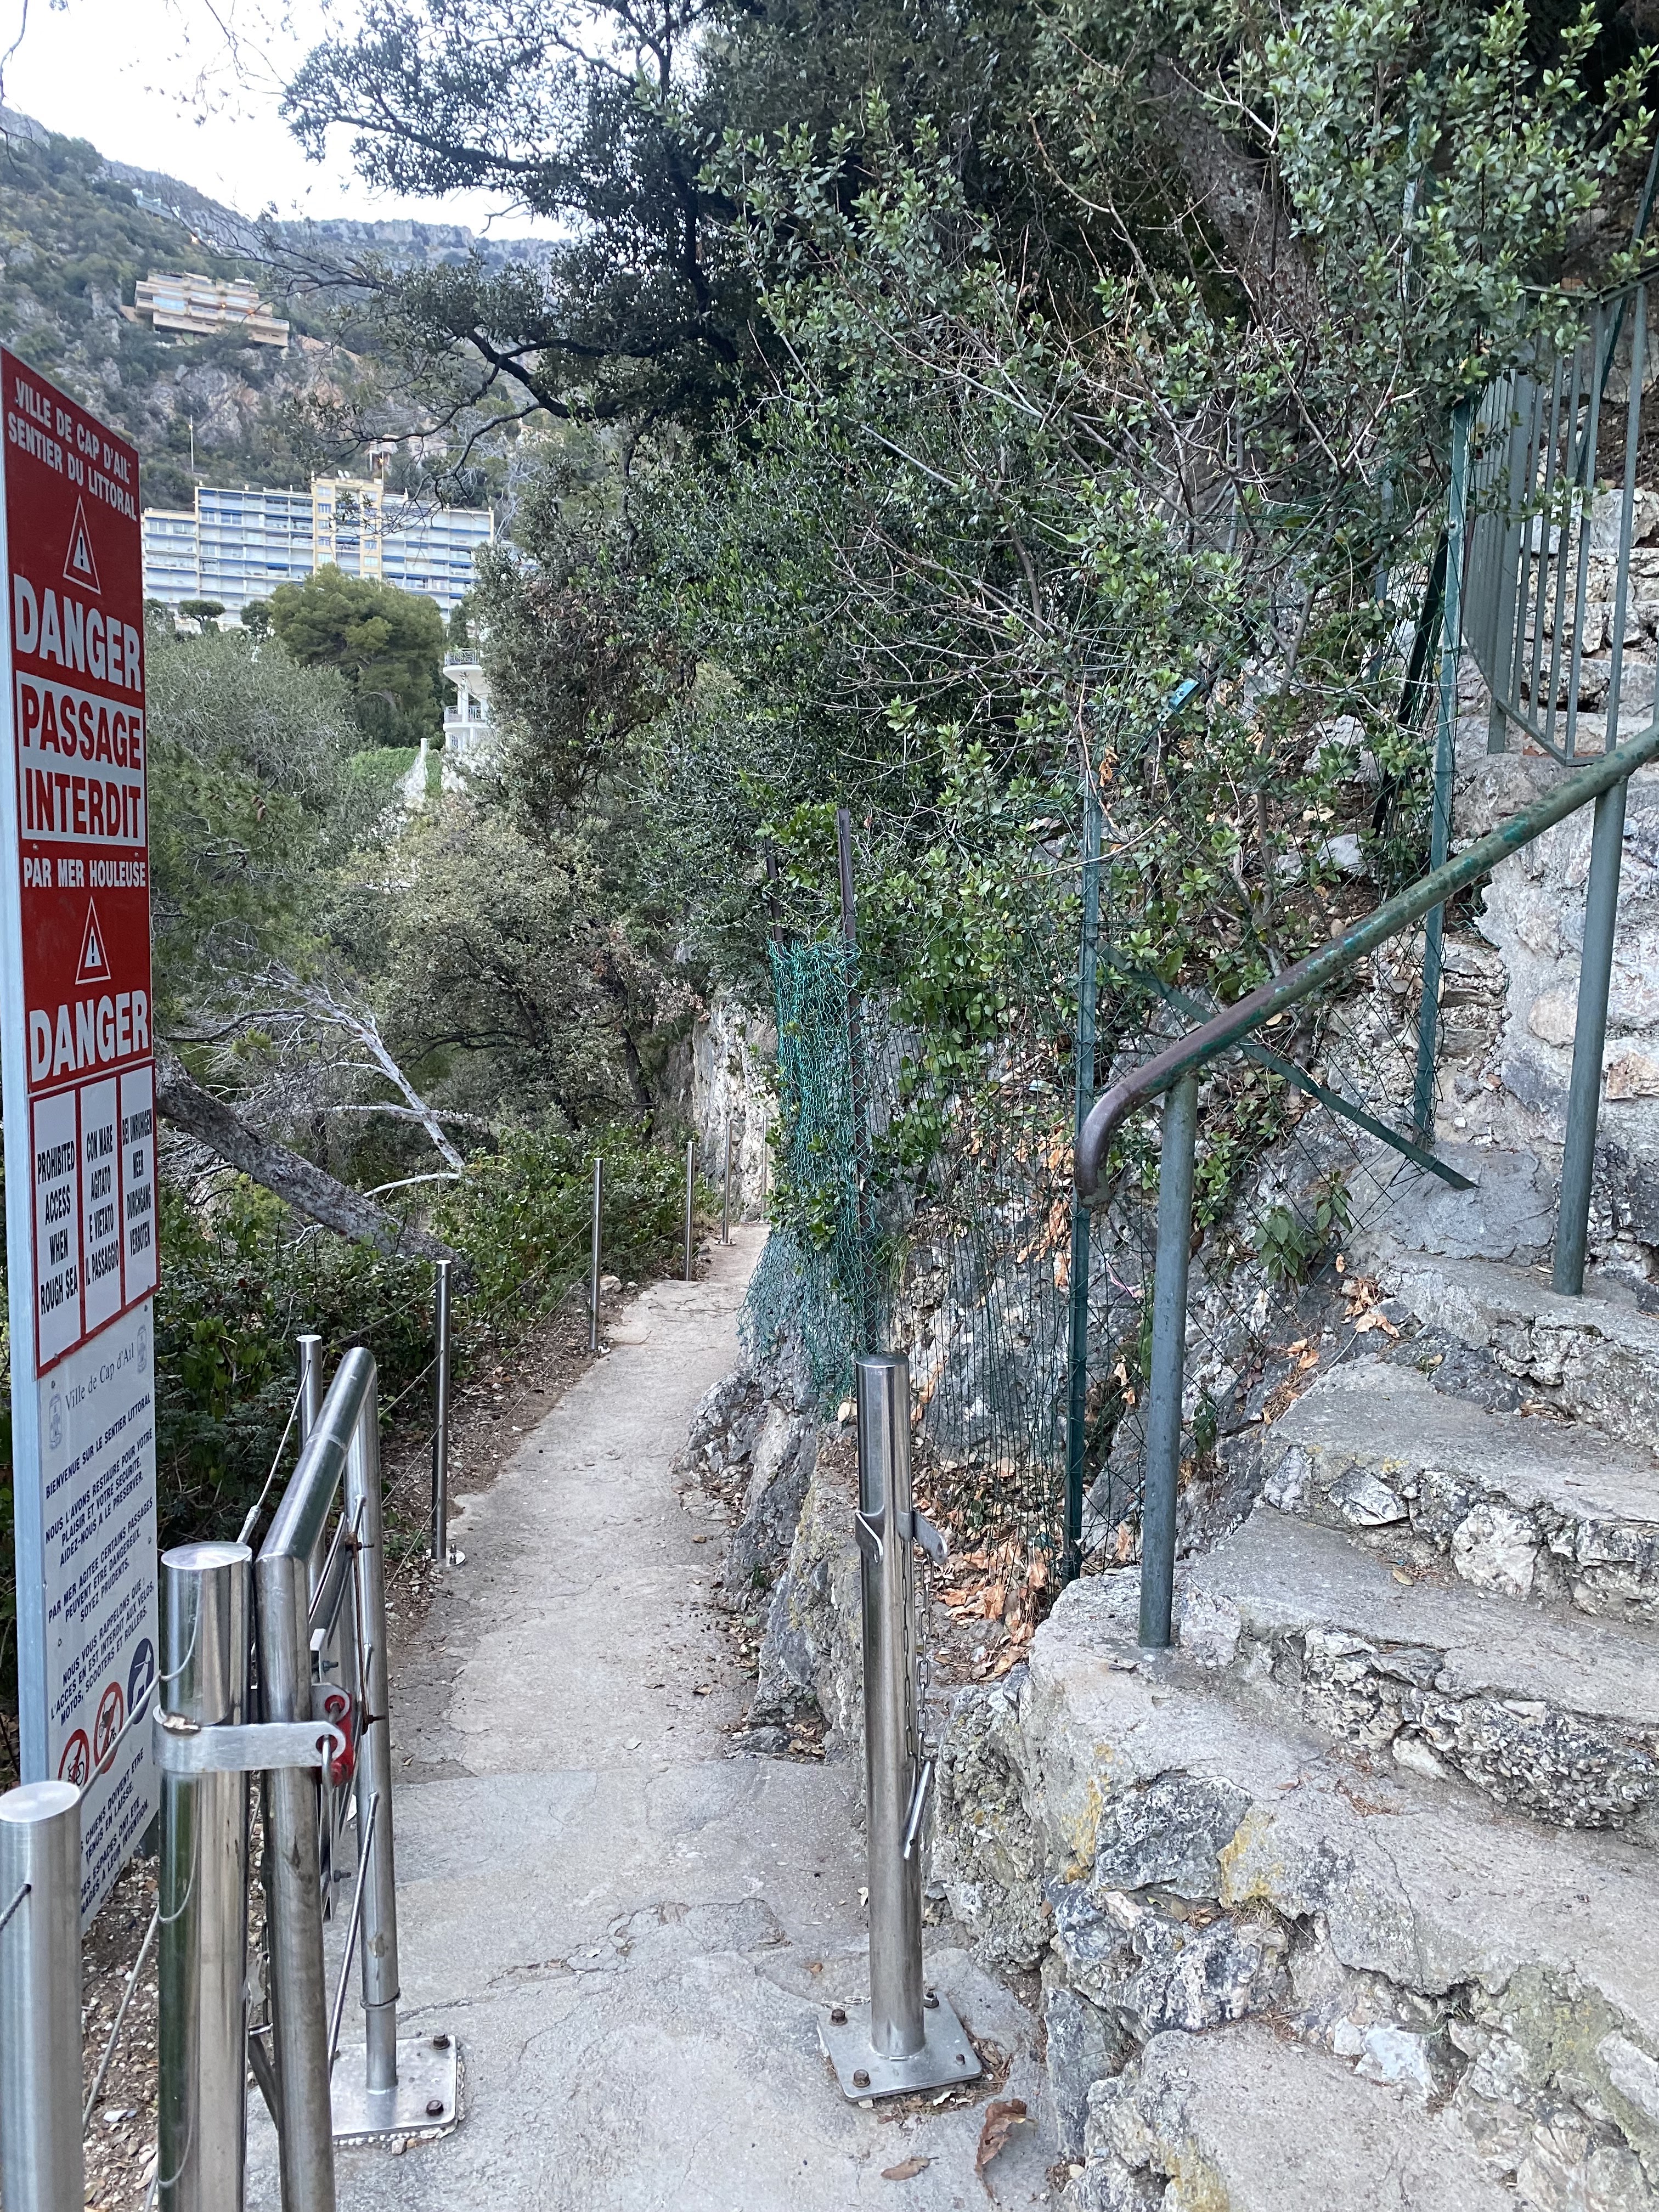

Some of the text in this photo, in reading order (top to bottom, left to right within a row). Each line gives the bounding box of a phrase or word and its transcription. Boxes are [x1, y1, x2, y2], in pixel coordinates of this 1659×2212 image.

[15, 377, 52, 429] VILLE
[56, 407, 72, 443] DE
[77, 424, 99, 460] CAP
[8, 412, 137, 522] SENTIER DU LITTORAL
[14, 573, 141, 692] DANGER
[21, 683, 141, 770] PASSAGE
[25, 768, 141, 838] INTERDIT
[23, 857, 146, 887] PAR MER HOULEUSE
[29, 990, 149, 1082] DANGER
[37, 1141, 75, 1184] PROHIBITED
[87, 1124, 113, 1163] CON MARE
[133, 1149, 144, 1179] MEER
[45, 1184, 71, 1225] ACCESS
[91, 1165, 111, 1201] AGITATO
[49, 1228, 68, 1266] WHEN
[89, 1203, 114, 1243] E VIETATO
[129, 1220, 150, 1257] VERBOTEN
[41, 1264, 78, 1315] ROUGH SEA
[86, 1239, 119, 1286] IL PASSAGGIO
[65, 1342, 134, 1410] Ville de Cap d'Ail
[46, 1392, 150, 1499] BIENVENUE SUR LE SENTIER LITTORAL
[46, 1427, 152, 1544] NOUS L'AVONS RESTAURE POUR VOTRE
[61, 1513, 85, 1546] PLAISIR
[87, 1503, 94, 1520] ET
[96, 1482, 114, 1510] VOTRE
[49, 1497, 153, 1624] PAR MER AGITEE CERTAINS PASSAGES
[60, 1519, 97, 1567] AIDEZ-NOUS
[99, 1513, 103, 1527] A
[105, 1503, 111, 1519] LE
[65, 1527, 141, 1622] PEUVENT ETRE DANGEREUX.
[81, 1558, 129, 1623] SOYEZ PRUDENTS.
[51, 1679, 76, 1720] L'ACCES
[79, 1665, 86, 1684] EN
[88, 1650, 99, 1672] EST
[101, 1616, 124, 1656] INTERDIT
[126, 1601, 137, 1624] AUX
[63, 1657, 80, 1686] NOUS
[82, 1635, 97, 1663] VOUS
[99, 1594, 129, 1640] RAPPELONS
[61, 1690, 83, 1726] MOTOS,
[86, 1646, 115, 1693] SCOOTERS
[116, 1635, 123, 1652] ET
[86, 1747, 143, 1844] CHIENS DOIVENT ETRE
[86, 1827, 103, 1862] TENUS
[105, 1813, 112, 1831] EN
[93, 1833, 117, 1880] ESPACES
[119, 1813, 129, 1837] ONT
[131, 1796, 139, 1818] ETE
[102, 1869, 106, 1882] A
[108, 1843, 121, 1873] LEUR
